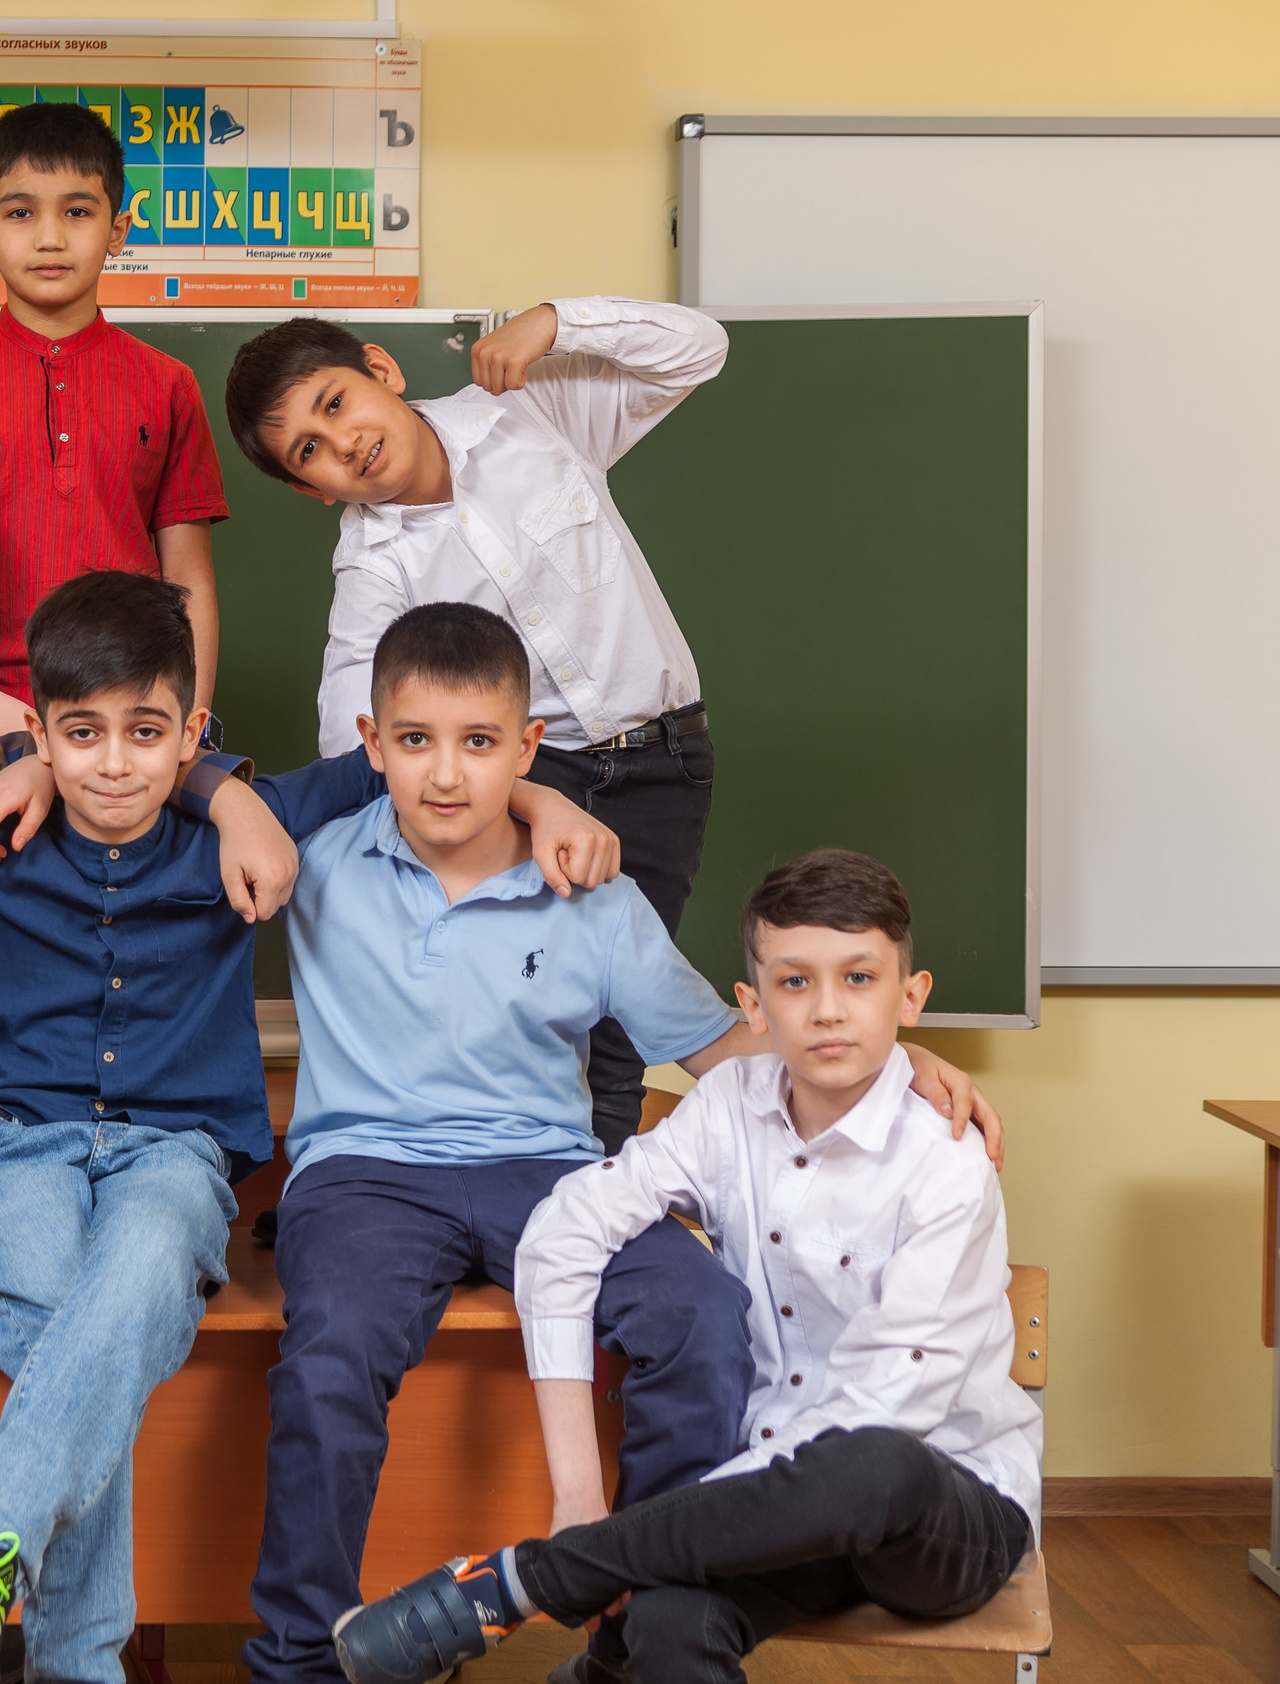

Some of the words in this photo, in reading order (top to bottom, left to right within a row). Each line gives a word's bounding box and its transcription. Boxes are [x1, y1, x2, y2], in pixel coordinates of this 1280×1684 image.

[64, 39, 108, 52] звуков
[246, 248, 296, 260] Непарные
[299, 251, 333, 261] глухие
[121, 263, 149, 273] звуки
